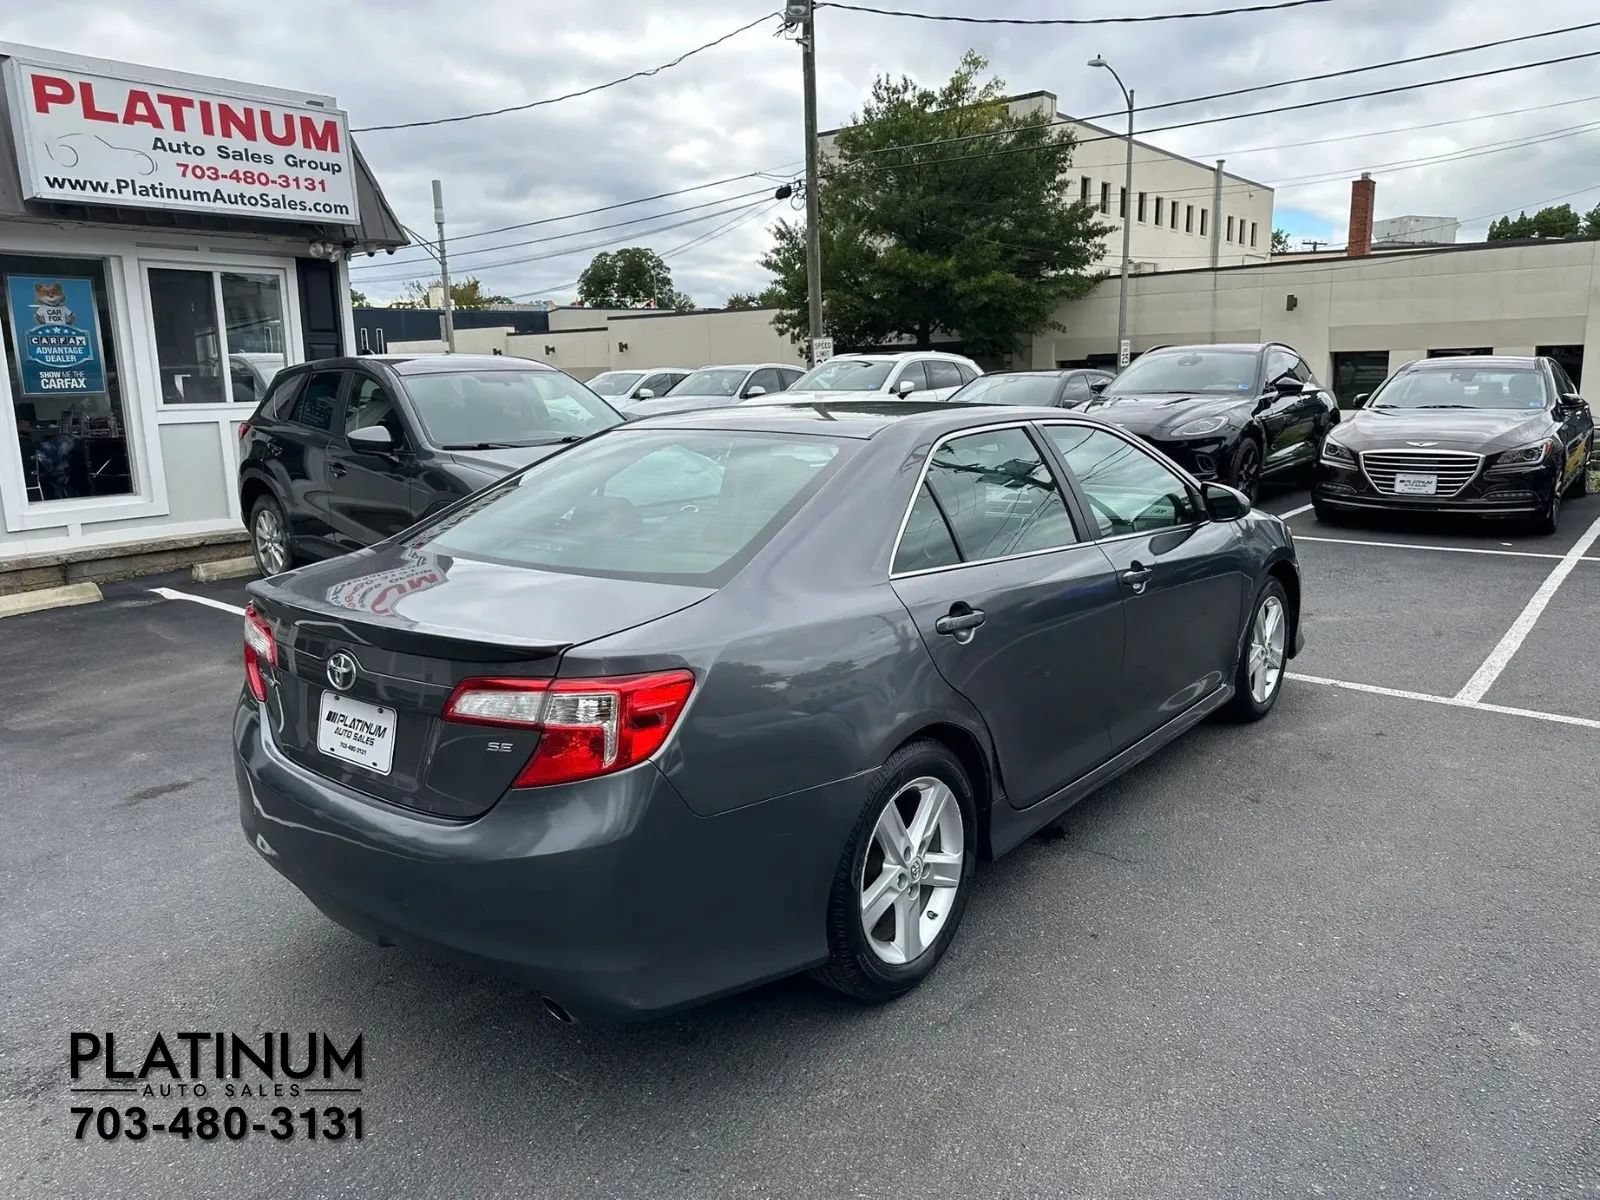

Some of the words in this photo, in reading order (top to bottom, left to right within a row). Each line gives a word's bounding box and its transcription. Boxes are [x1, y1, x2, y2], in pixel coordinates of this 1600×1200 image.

[31, 73, 340, 153] PLATINUM
[152, 136, 206, 157] Auto
[217, 144, 274, 166] Sales
[284, 154, 343, 175] Group
[176, 162, 327, 193] 703-480-3131
[44, 174, 350, 216] www.PlatinumAutoSales.com
[31, 336, 86, 345] CARFAX
[36, 347, 84, 355] ADVANTAGE
[45, 354, 77, 362] DEALER
[39, 371, 61, 379] SHOW
[41, 378, 87, 389] CARFAX
[336, 713, 388, 739] PLATINUM
[333, 727, 353, 739] AUTO
[352, 732, 375, 747] SALES
[486, 741, 514, 753] SE
